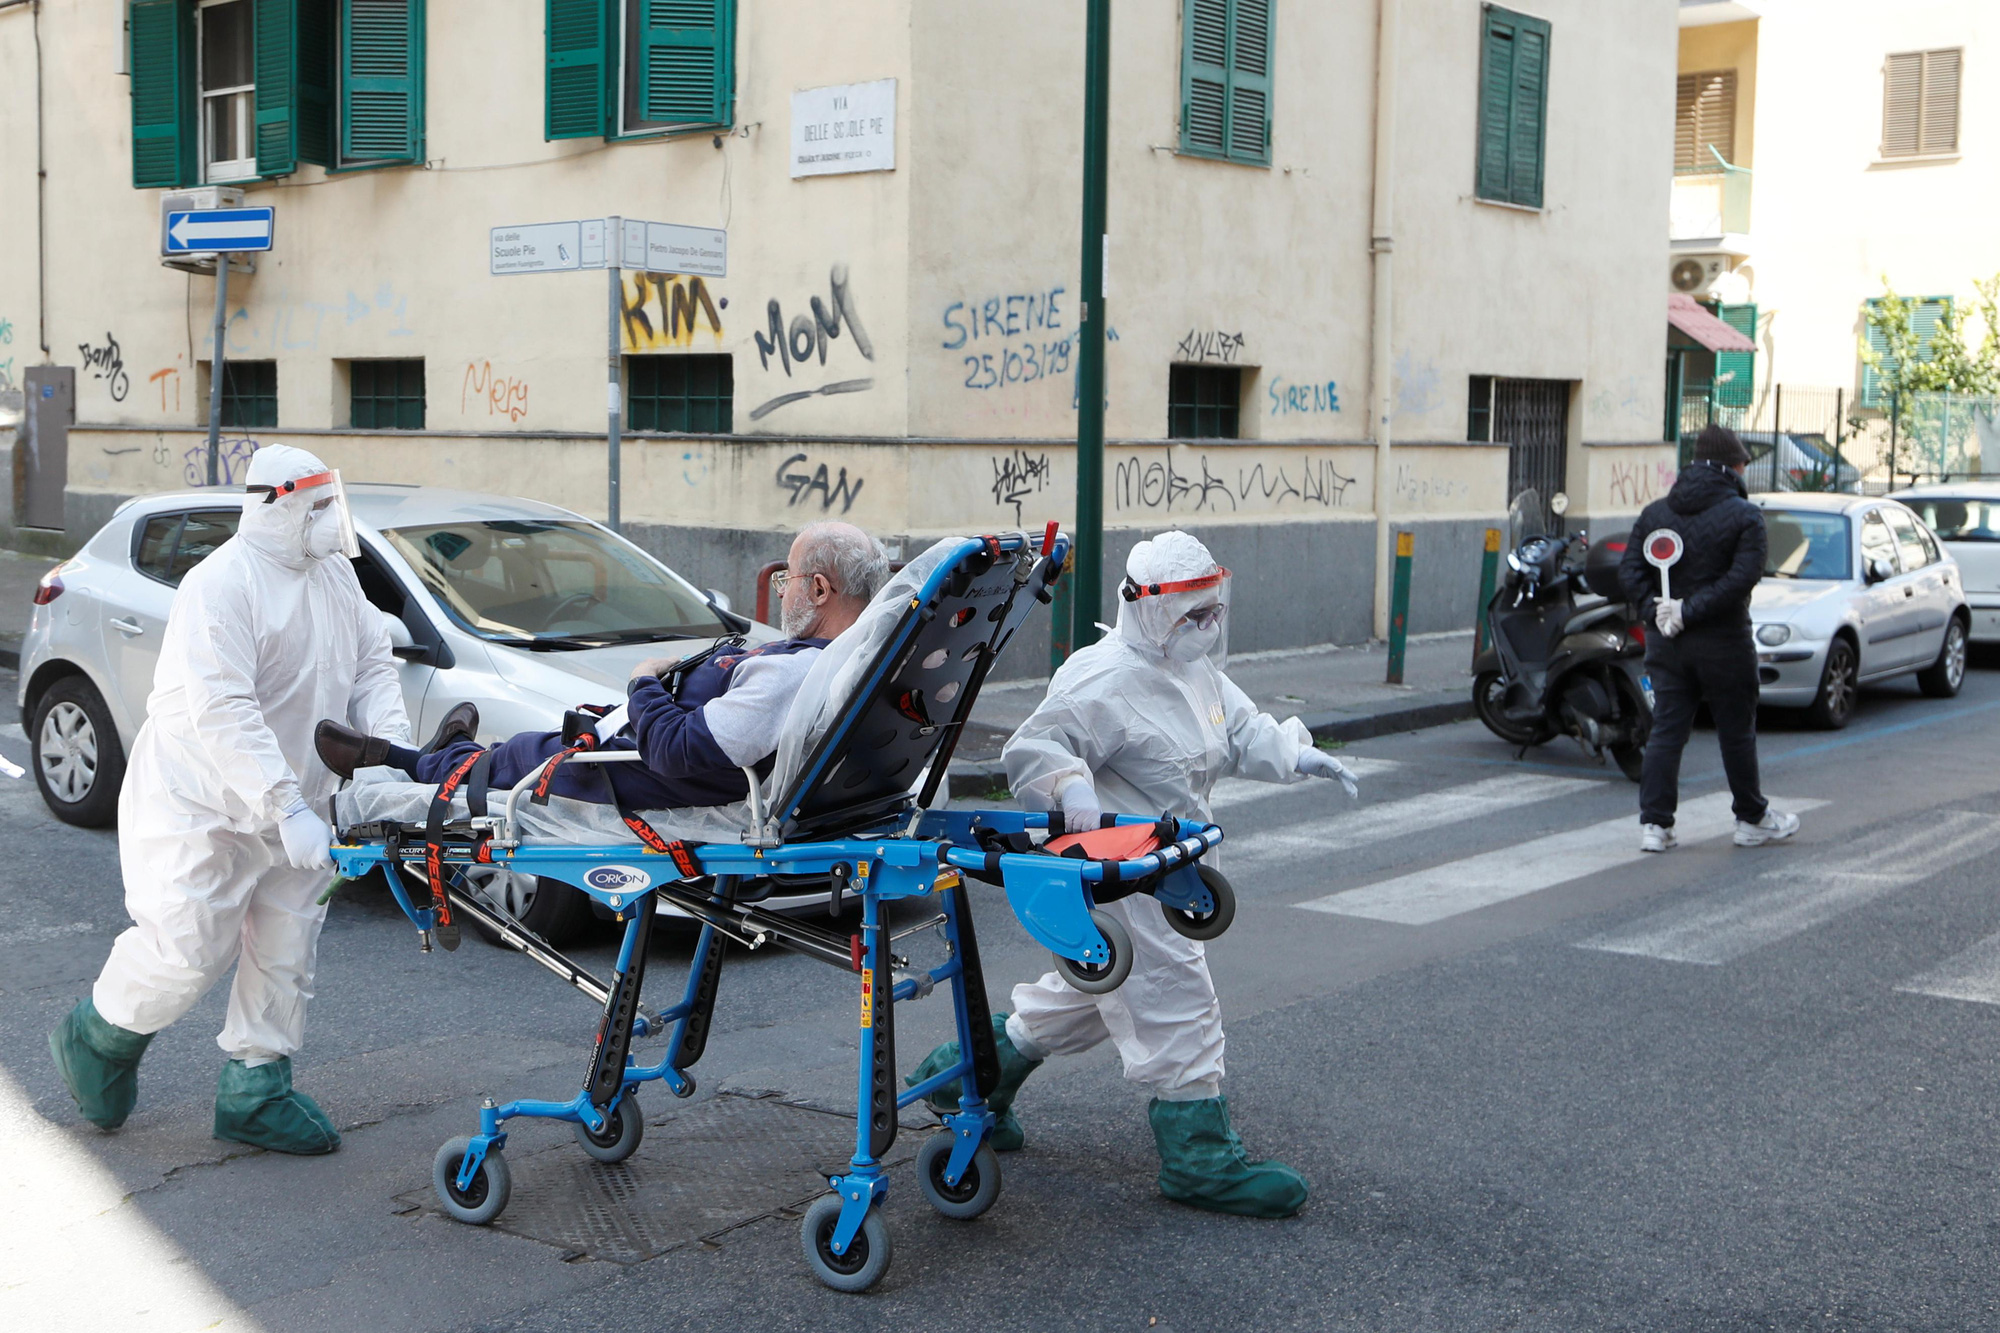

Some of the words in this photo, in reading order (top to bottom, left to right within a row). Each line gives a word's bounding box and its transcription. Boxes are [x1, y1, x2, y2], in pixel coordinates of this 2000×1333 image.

[833, 96, 848, 111] VIA
[804, 122, 829, 142] DELLE
[834, 119, 865, 139] SCOLE
[494, 234, 504, 242] via
[505, 232, 520, 241] delle
[494, 246, 521, 258] Scuole
[523, 244, 536, 256] Pie
[650, 242, 667, 254] Pietro
[669, 245, 689, 256] Jacopo
[690, 247, 698, 256] De
[700, 248, 723, 259] Gennaro
[754, 262, 875, 378] MOM
[943, 288, 1065, 350] SIRENE
[595, 873, 644, 885] ORION
[583, 1041, 600, 1088] MERCURY
